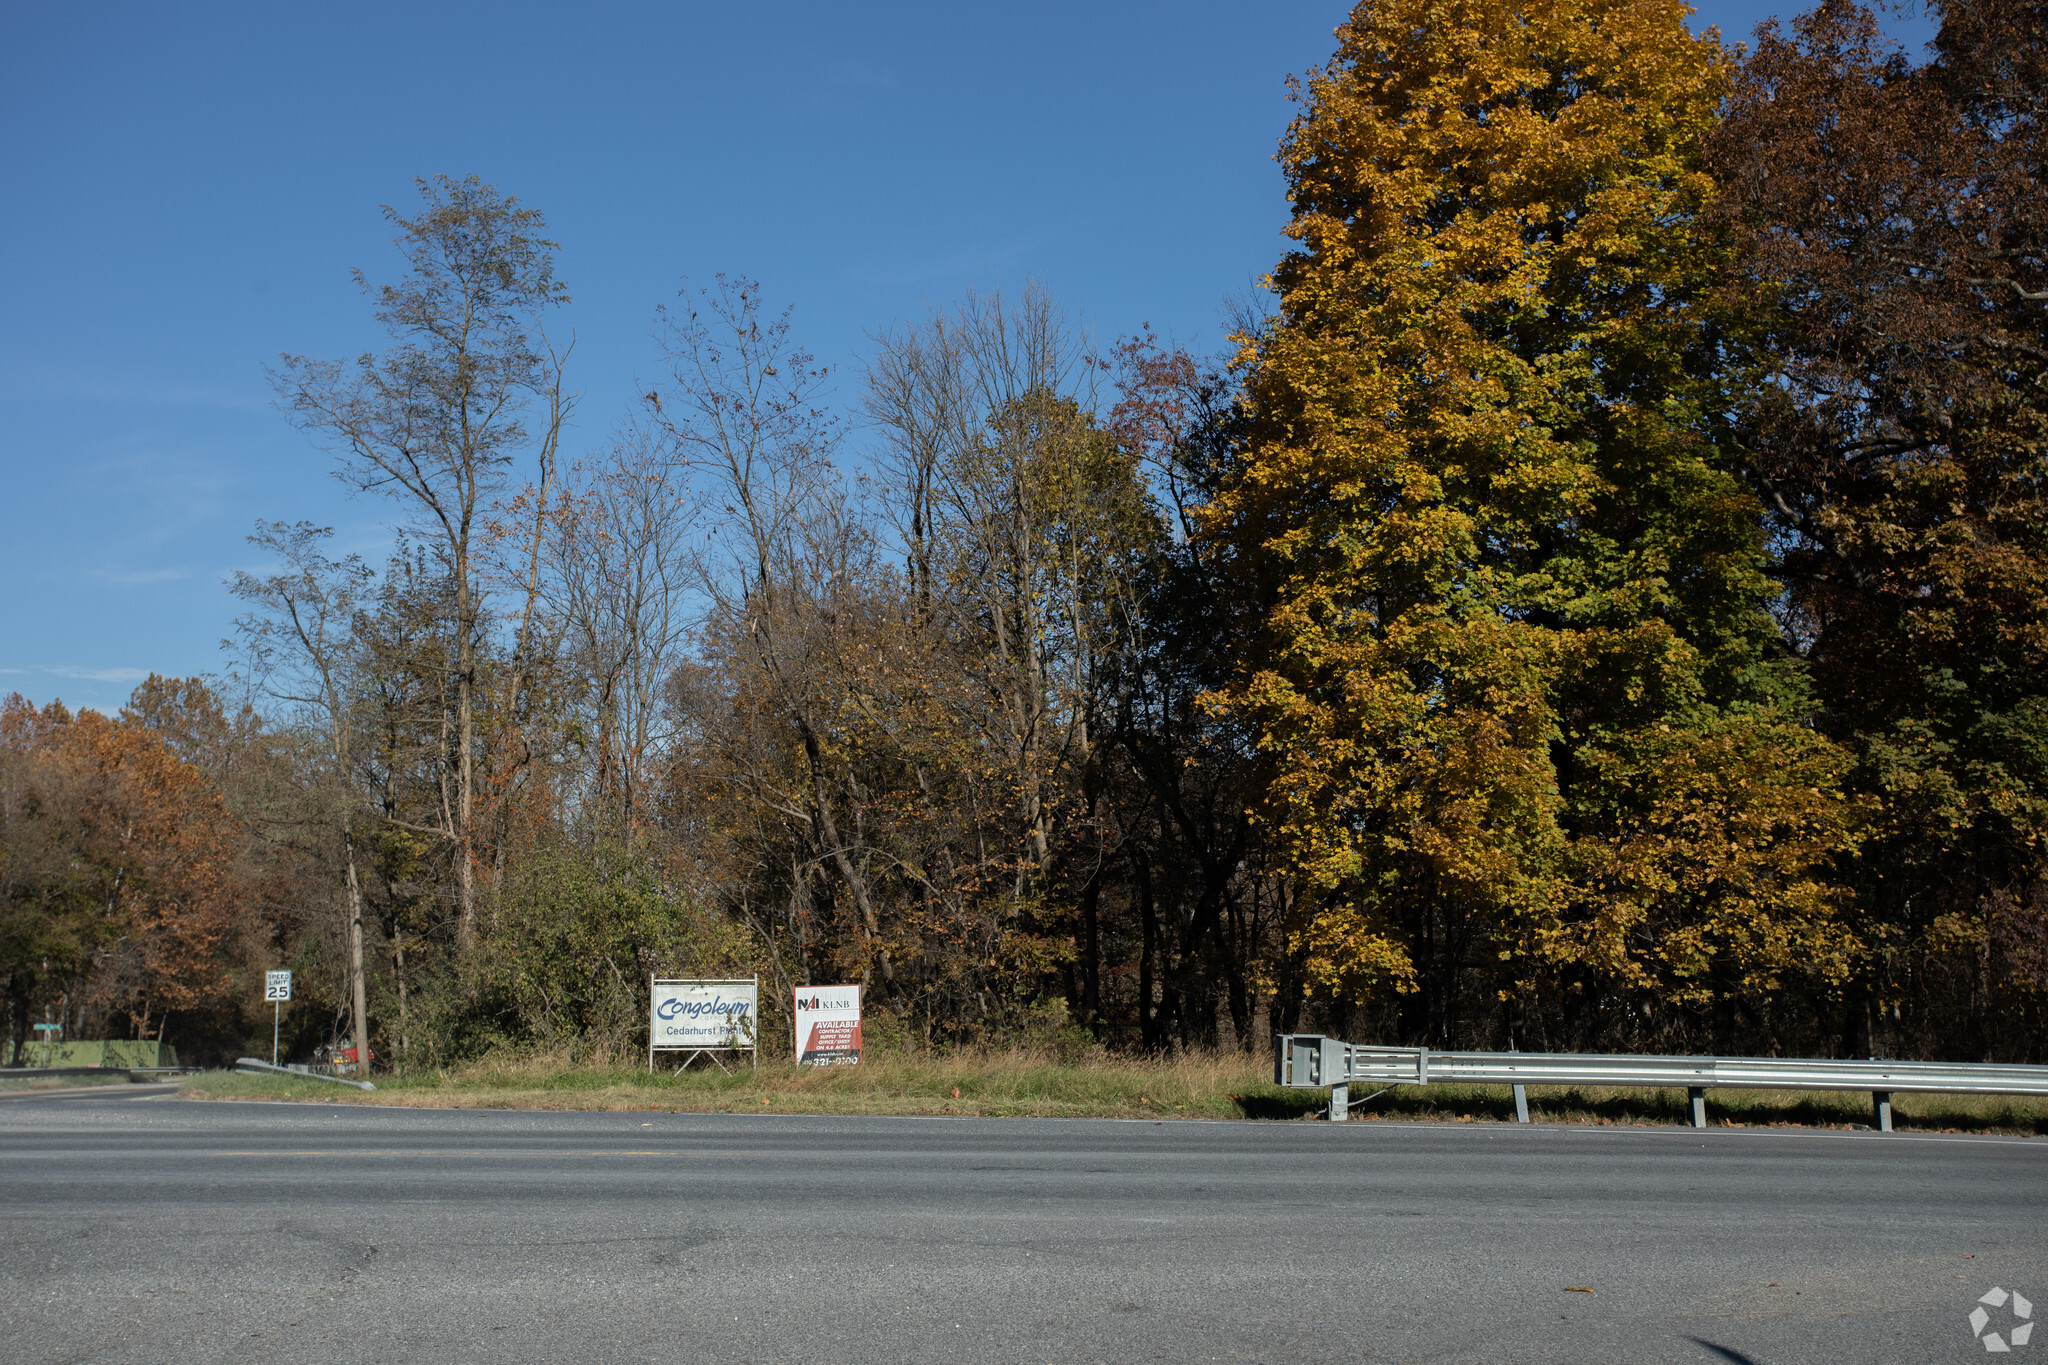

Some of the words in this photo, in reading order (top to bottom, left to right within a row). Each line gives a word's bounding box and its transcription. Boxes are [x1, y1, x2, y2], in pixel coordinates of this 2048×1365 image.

[268, 987, 288, 998] 25
[657, 995, 749, 1020] Congoleum
[798, 994, 820, 1011] NAI
[823, 1001, 849, 1009] KLNB
[666, 1026, 716, 1035] Cedarhurst
[816, 1021, 858, 1029] AVAILABLE
